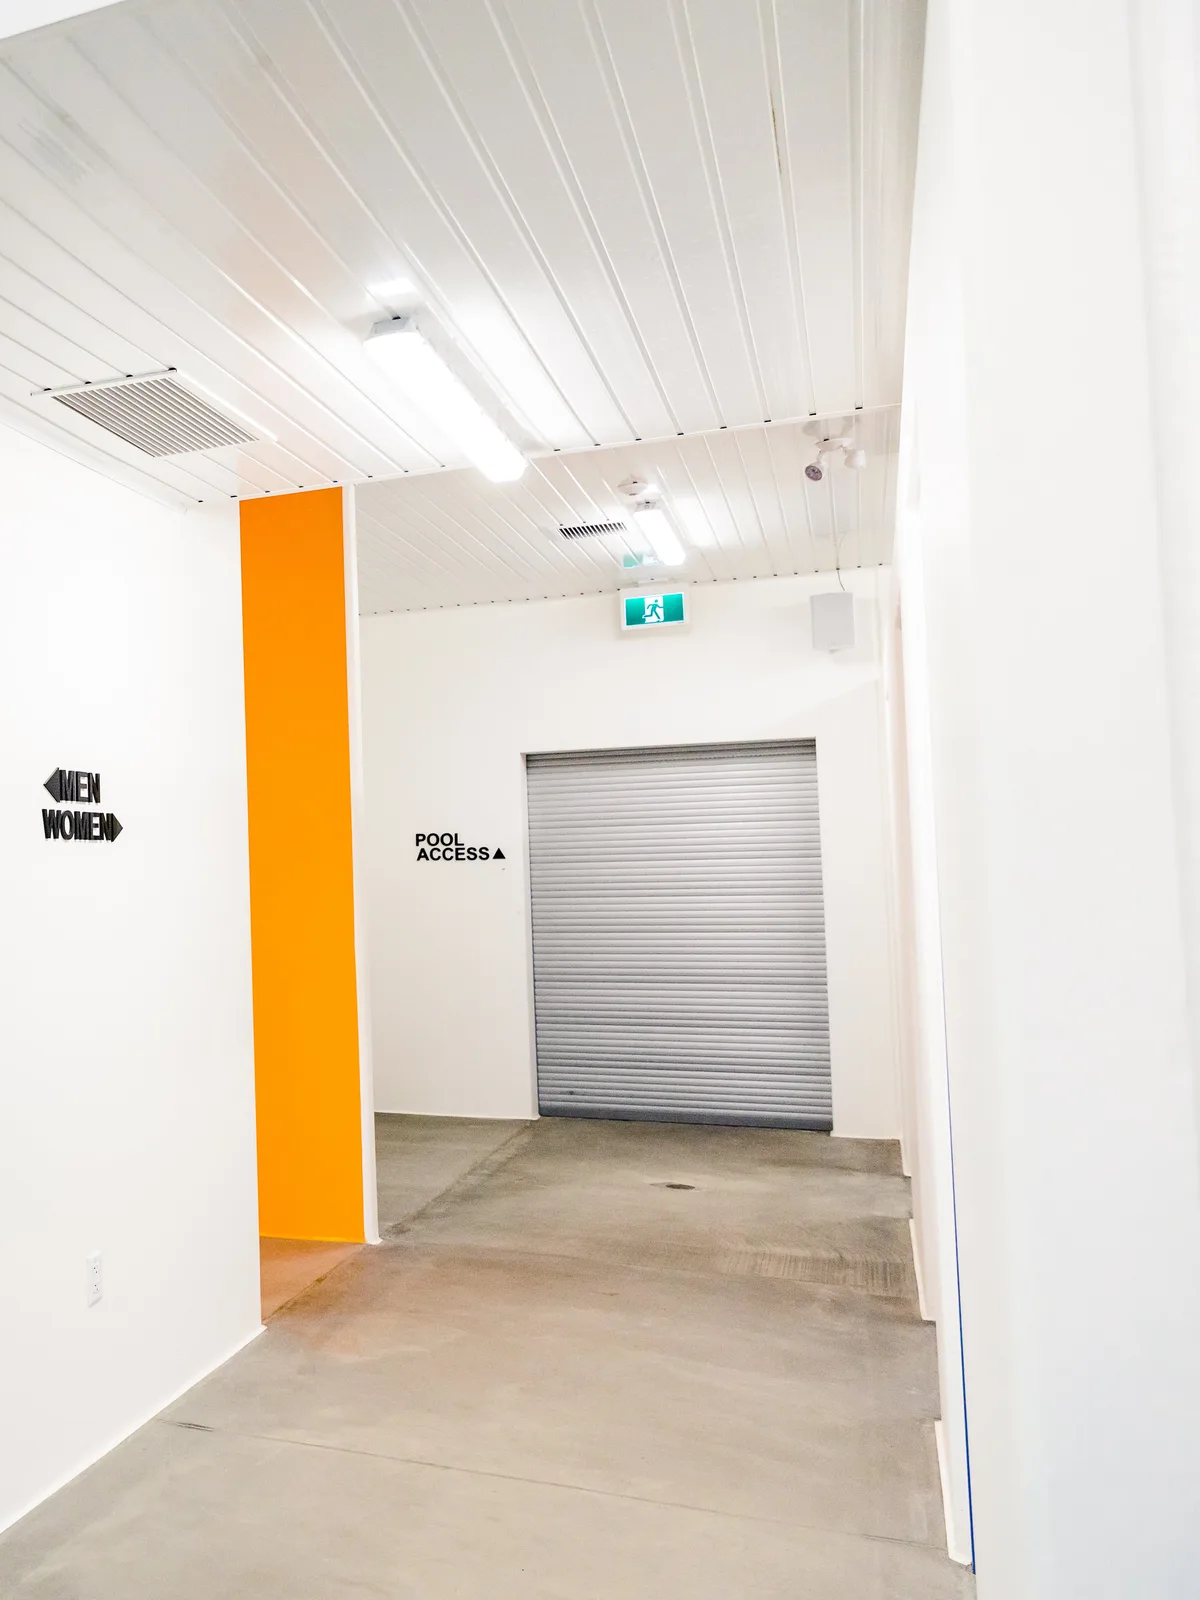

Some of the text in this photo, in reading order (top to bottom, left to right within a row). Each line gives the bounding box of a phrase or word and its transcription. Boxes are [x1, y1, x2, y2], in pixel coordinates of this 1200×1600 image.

[59, 769, 101, 804] MEN
[41, 808, 113, 842] WOMEN
[415, 832, 465, 847] POOL
[416, 846, 490, 862] ACCESS
